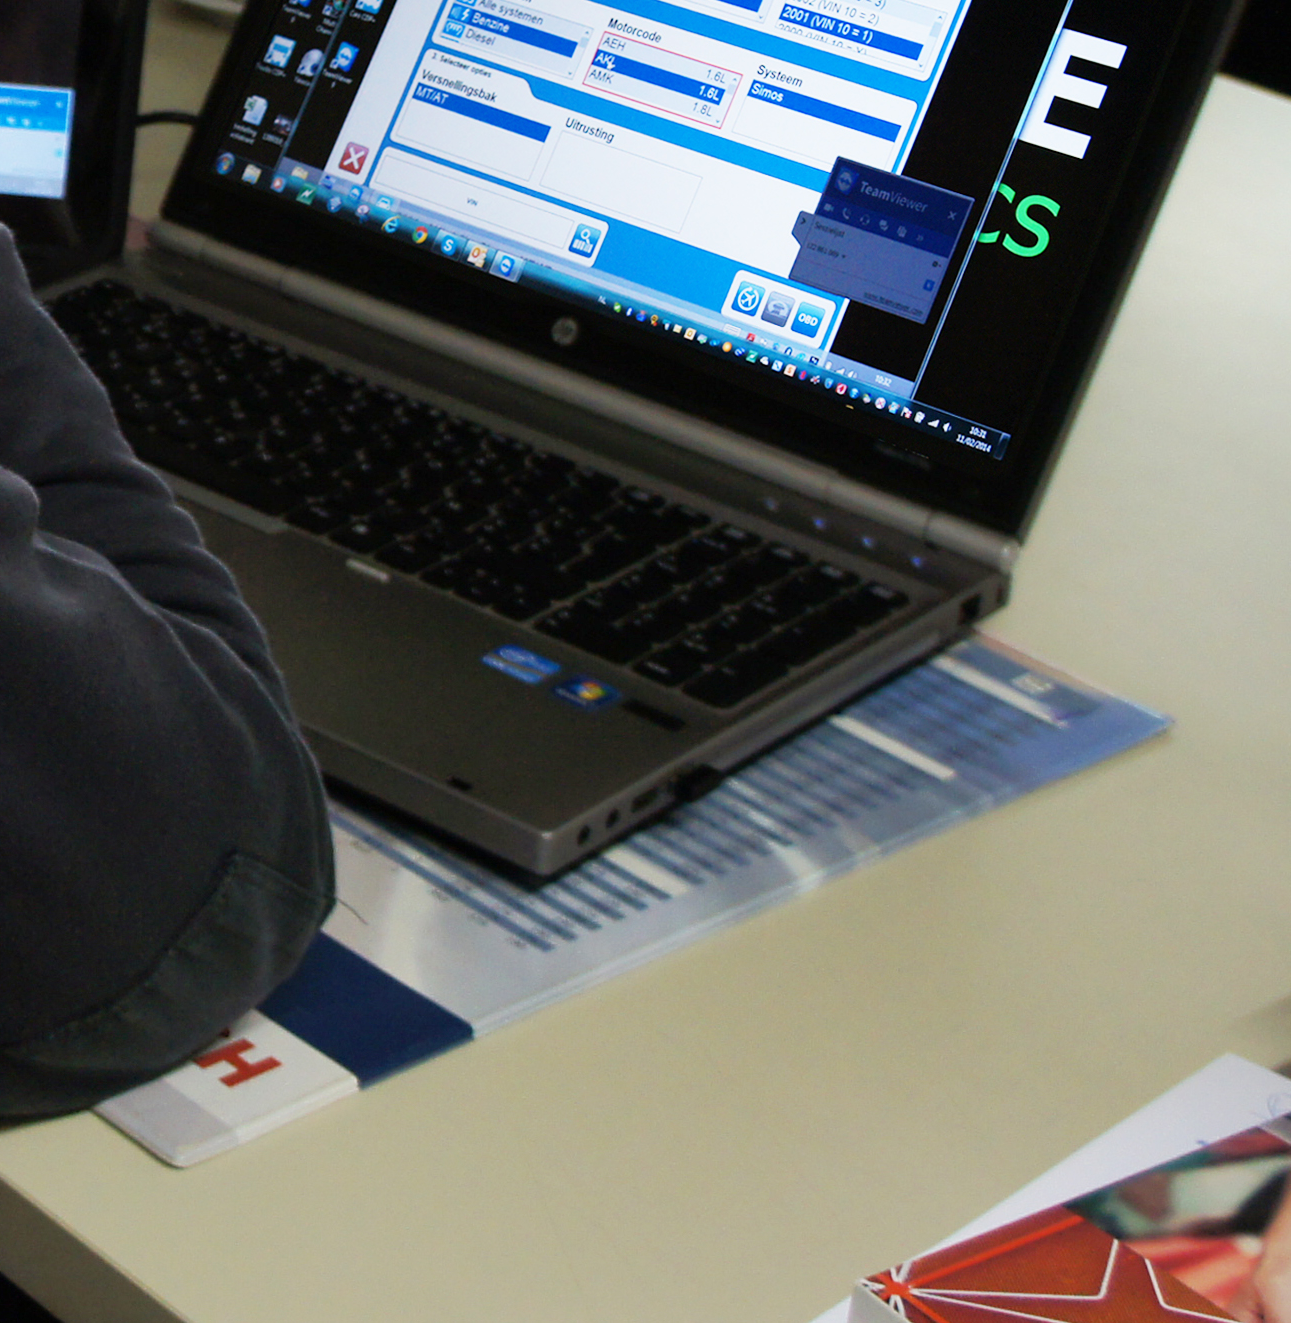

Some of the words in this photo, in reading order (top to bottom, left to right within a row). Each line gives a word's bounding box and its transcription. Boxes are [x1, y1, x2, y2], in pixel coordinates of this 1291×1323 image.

[471, 12, 511, 34] Benzine
[498, 2, 544, 26] systemen
[844, 7, 857, 19] 10
[867, 14, 880, 27] 2)
[608, 18, 662, 43] Motorcode
[782, 6, 809, 24] 2001
[810, 14, 836, 31] (VIN
[837, 22, 851, 36] 10
[861, 30, 874, 44] 1)
[465, 28, 496, 46] Diesel
[602, 36, 627, 52] AEH
[439, 54, 471, 71] Selecteer
[470, 65, 492, 79] opties
[588, 68, 614, 85] AMK
[705, 68, 726, 85] 1.6L
[756, 64, 804, 88] Systeem
[415, 85, 450, 105] MT/AT
[421, 68, 497, 103] Versnellingsbak
[698, 85, 721, 101] 1.6L
[750, 83, 785, 103] Simos
[692, 102, 713, 118] 1.8L
[564, 116, 615, 144] Uitrusting
[859, 180, 928, 213] TeamViewer
[798, 313, 819, 327] OBD
[875, 374, 893, 388] 10:32
